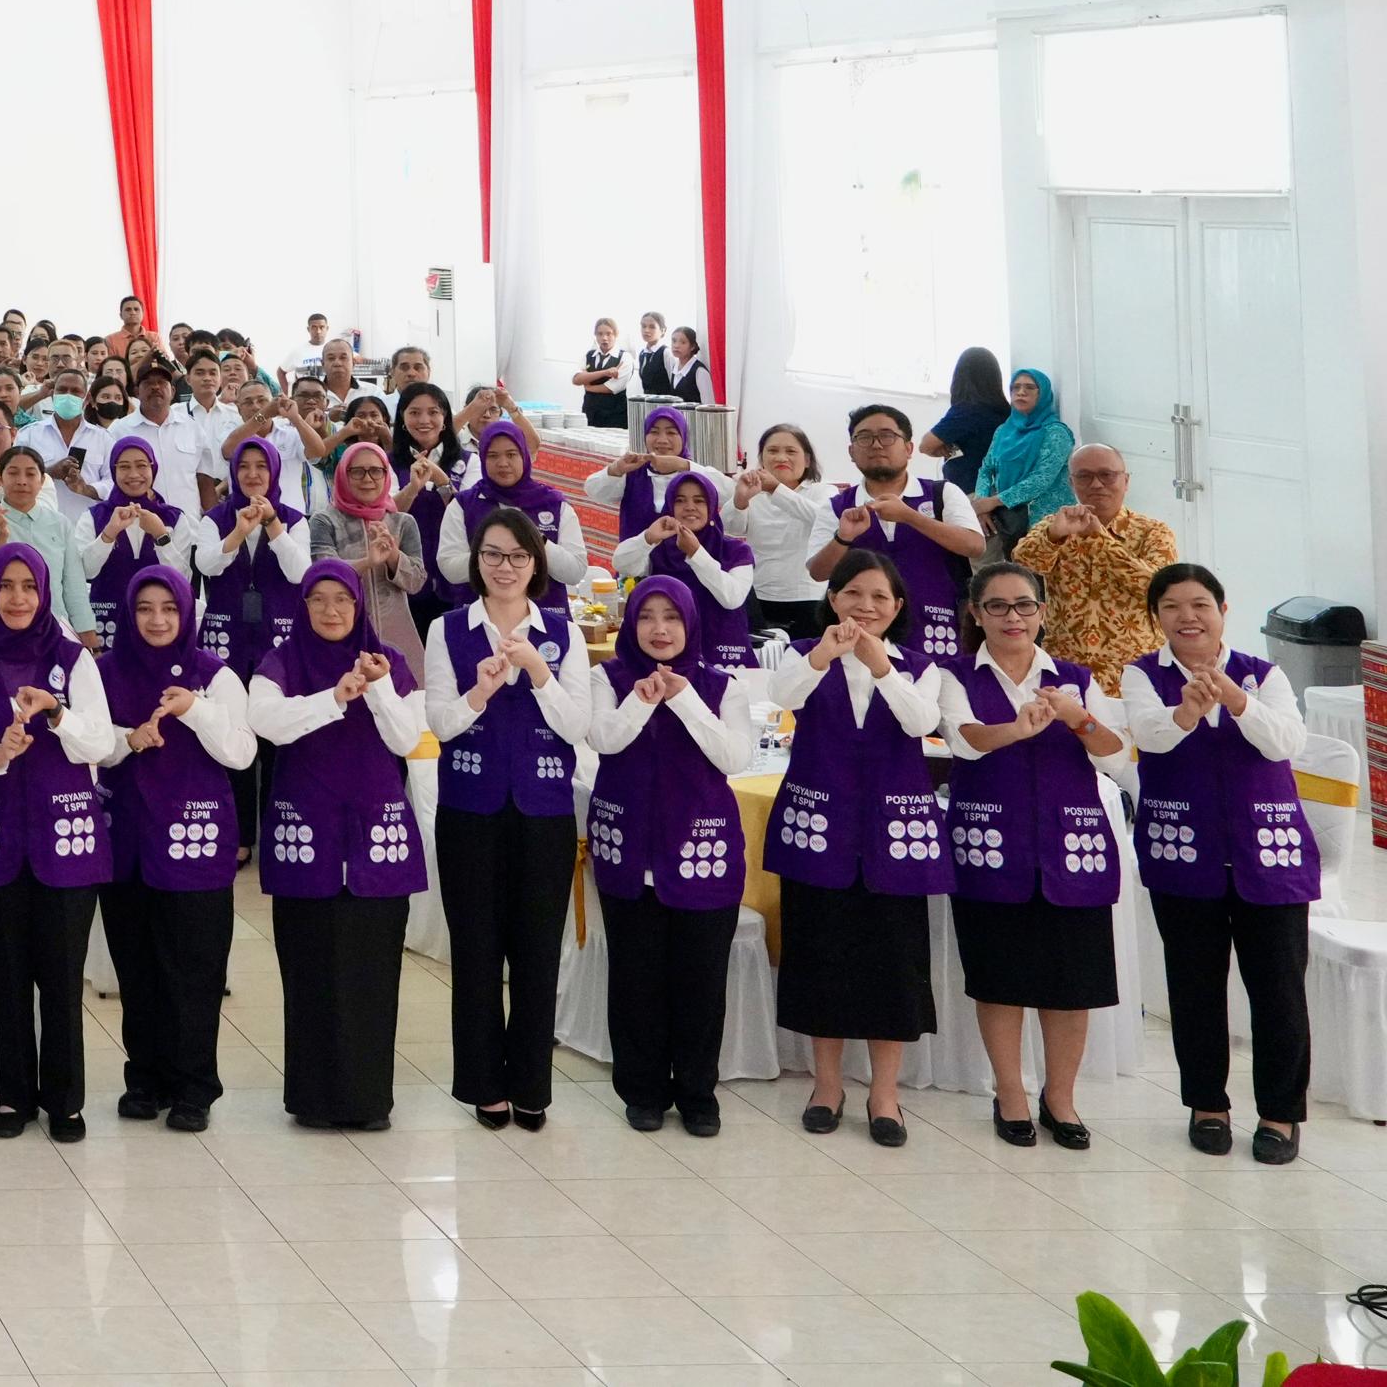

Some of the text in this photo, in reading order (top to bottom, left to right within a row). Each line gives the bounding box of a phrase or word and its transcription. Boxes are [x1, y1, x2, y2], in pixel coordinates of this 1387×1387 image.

[786, 782, 829, 802] POSYANDU
[52, 791, 92, 804] POSYANDU
[885, 794, 933, 805] POSYANDU
[70, 802, 87, 812] SPM
[185, 801, 218, 809] SYANDU
[275, 800, 294, 810] POSYA
[798, 797, 815, 809] SPM
[956, 801, 1002, 813] POSYANDU
[1143, 798, 1190, 811] POSYANDU
[1254, 802, 1297, 812] POSYANDU
[191, 811, 210, 820] SPM
[1064, 807, 1103, 816] POSYANDU
[1158, 810, 1179, 820] SPM
[970, 812, 990, 822] SPM
[1084, 817, 1098, 826] SPM
[694, 818, 726, 827] SYANDU
[699, 828, 716, 837] SPM
